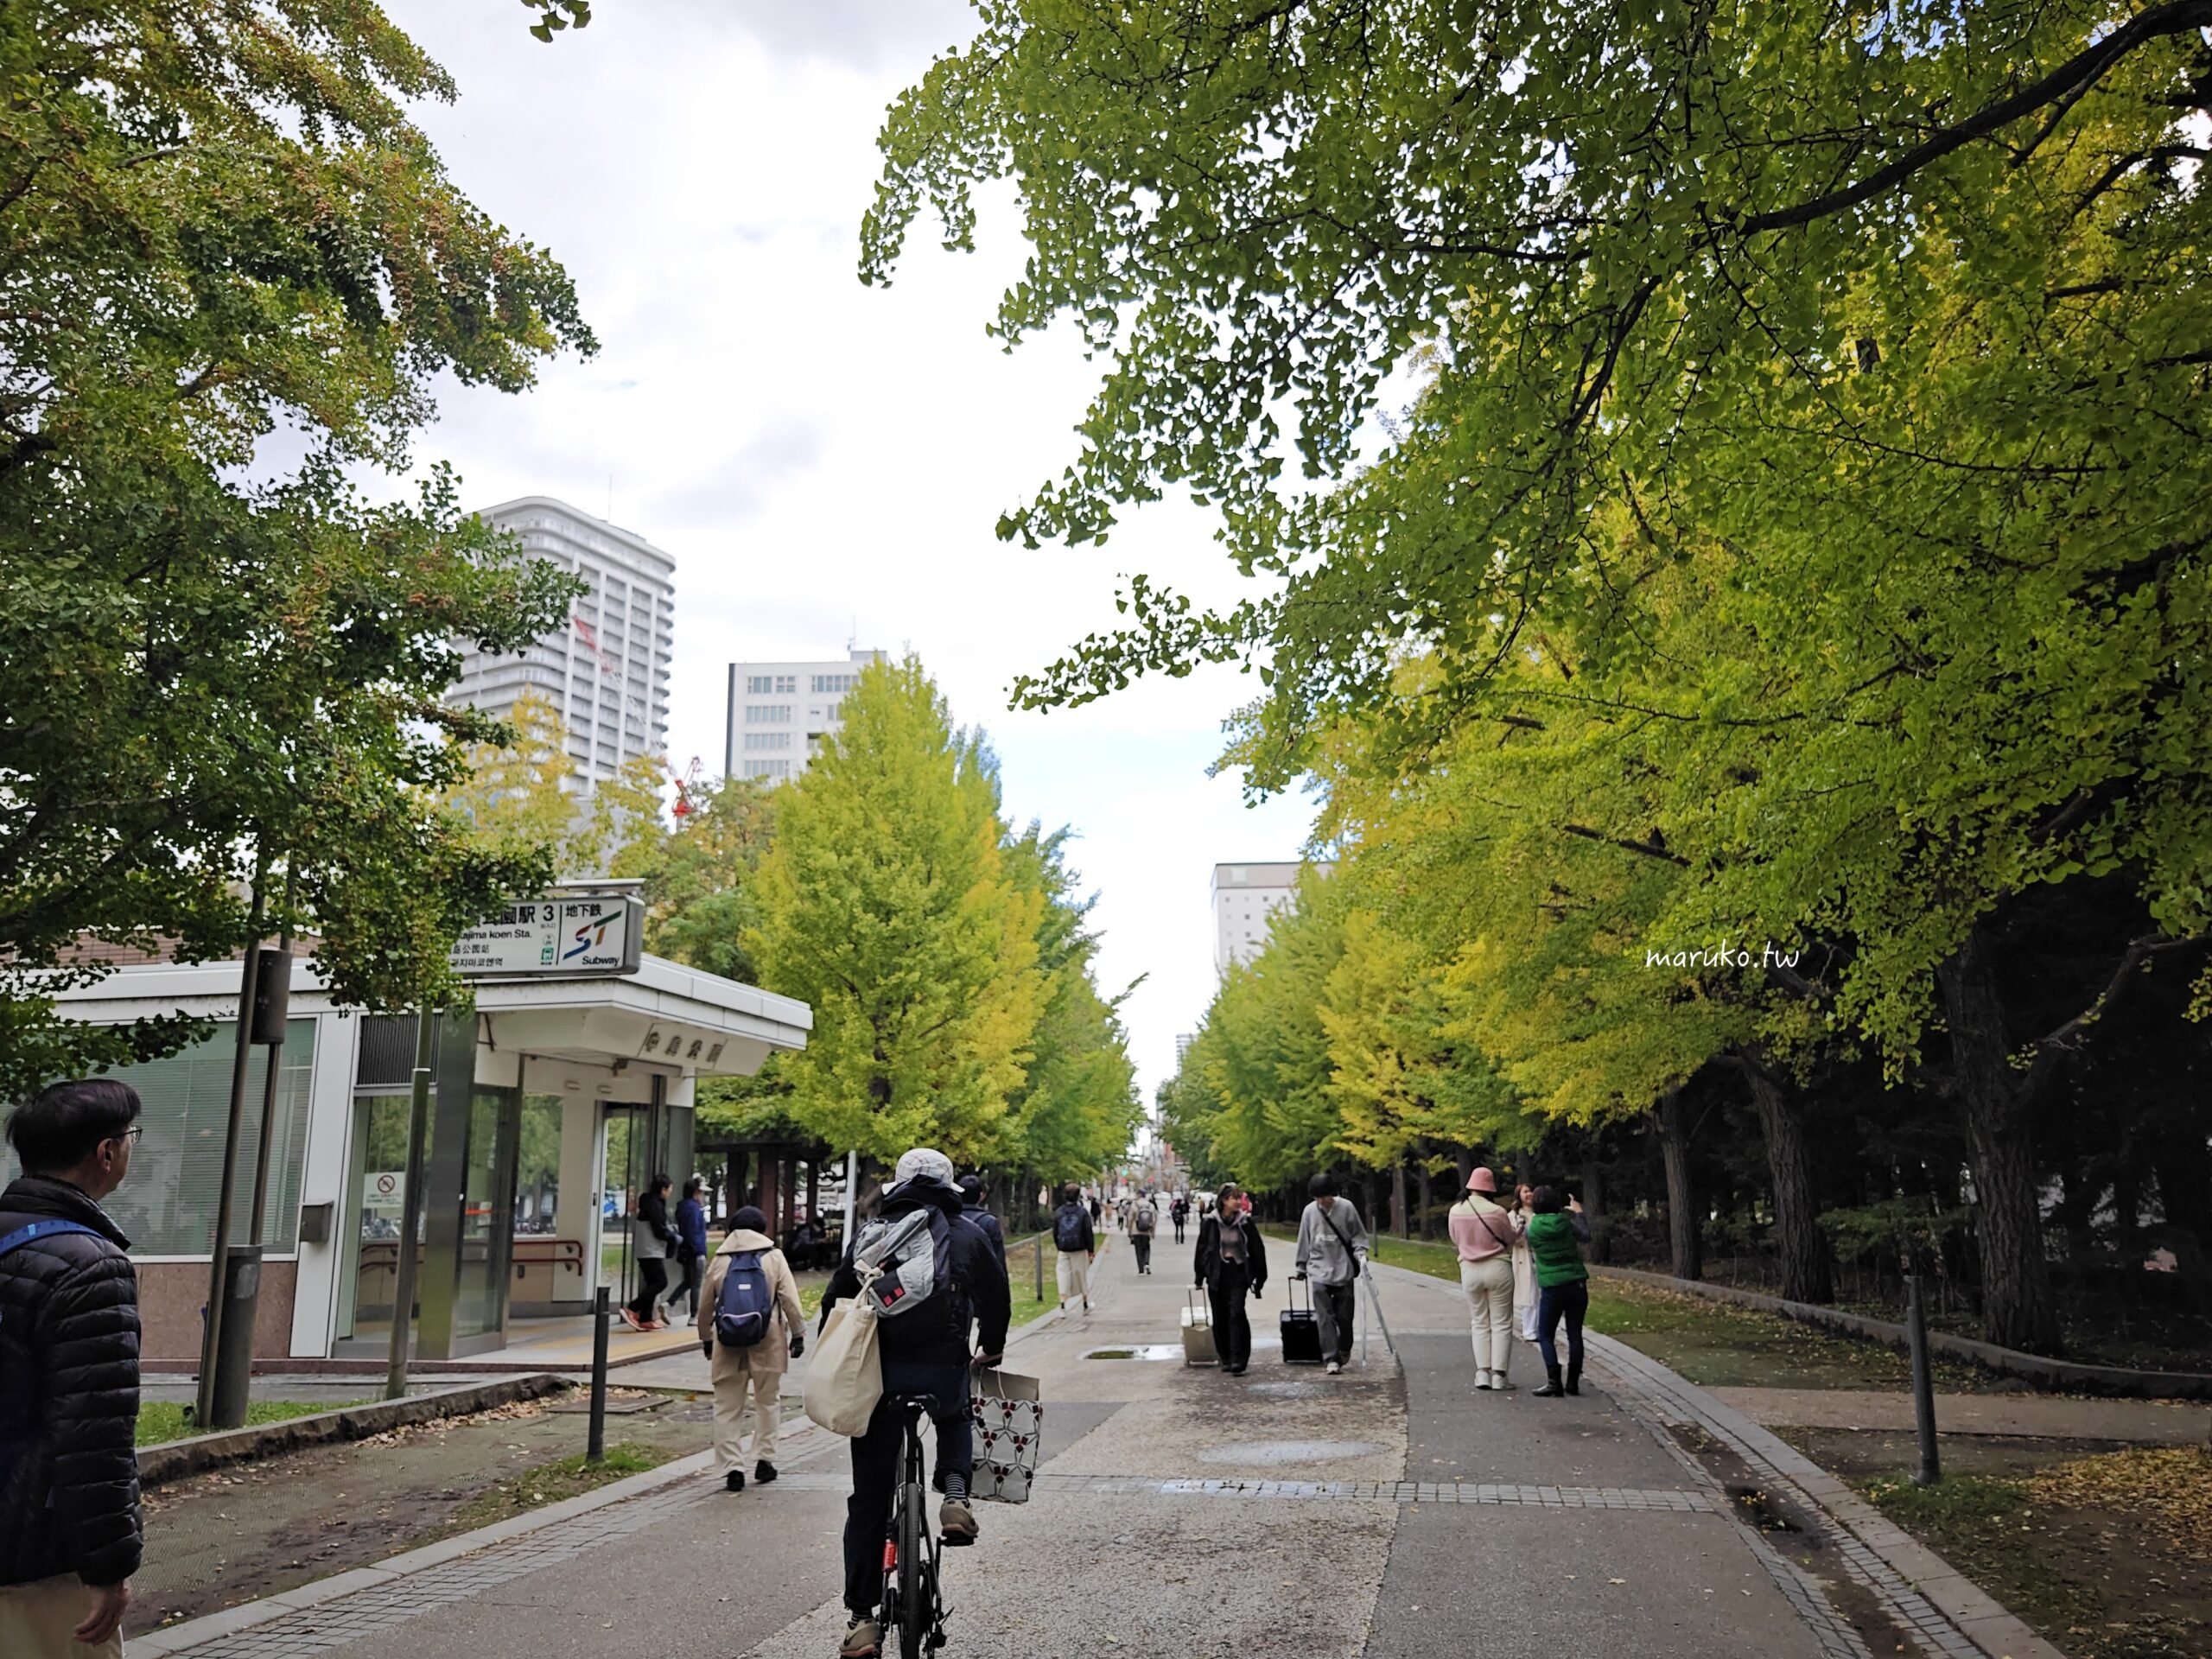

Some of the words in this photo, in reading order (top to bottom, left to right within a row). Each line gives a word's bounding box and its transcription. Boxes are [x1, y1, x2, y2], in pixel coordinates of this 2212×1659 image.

[543, 905, 555, 922] 3
[565, 903, 602, 917] 地下鉄
[460, 931, 487, 942] ajima
[489, 930, 512, 939] koen
[514, 928, 532, 938] Sta.
[582, 955, 620, 967] Subway
